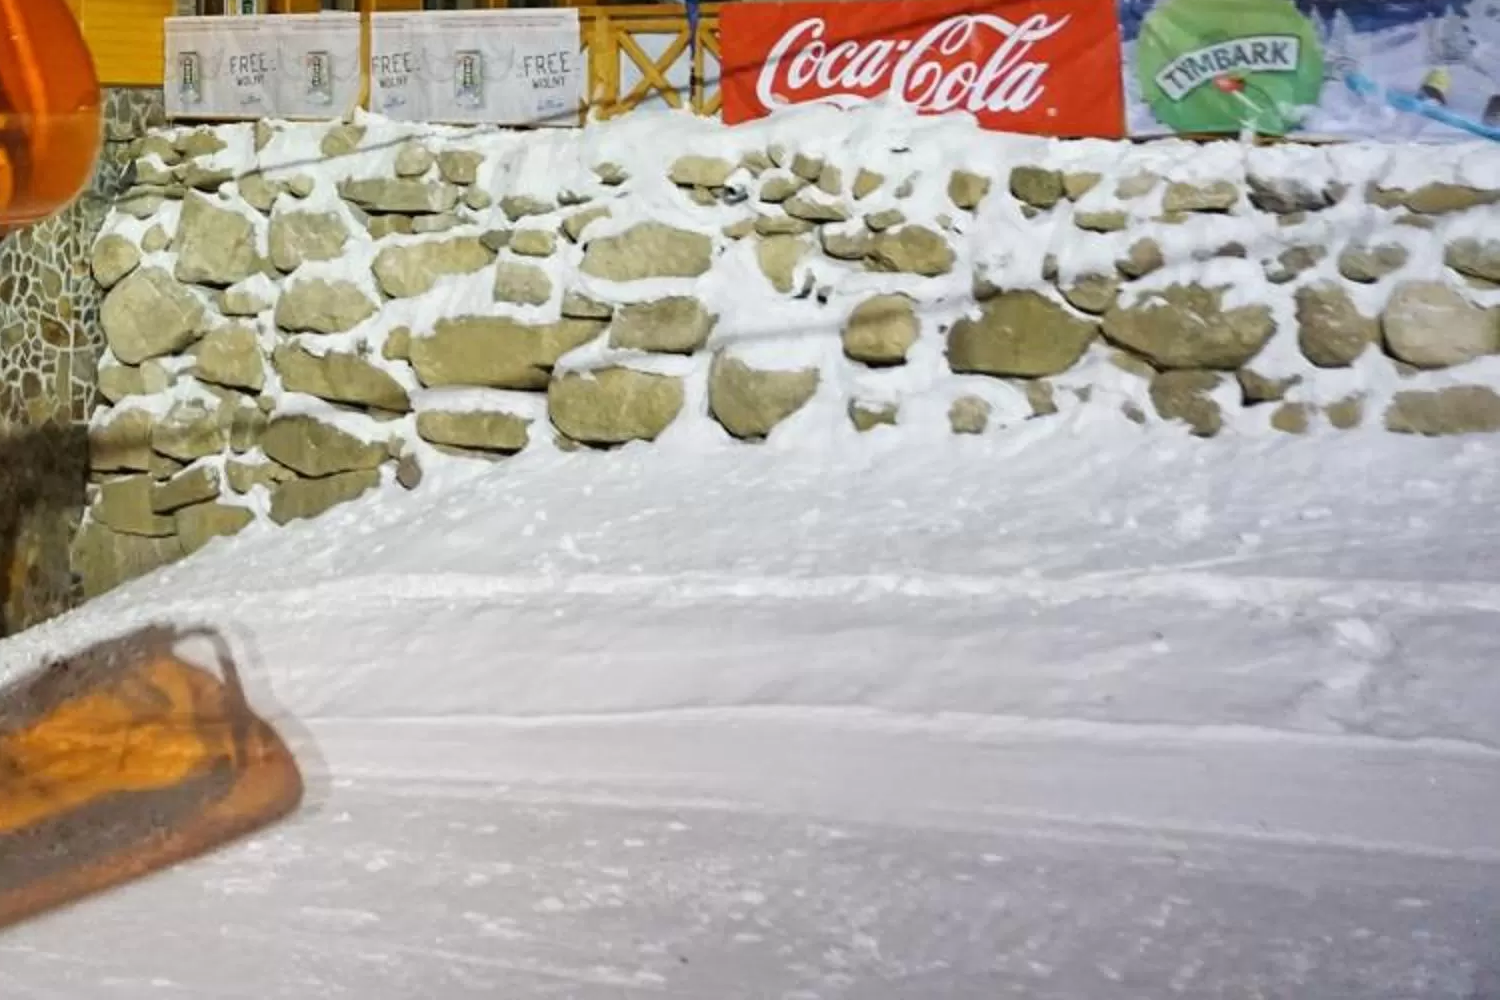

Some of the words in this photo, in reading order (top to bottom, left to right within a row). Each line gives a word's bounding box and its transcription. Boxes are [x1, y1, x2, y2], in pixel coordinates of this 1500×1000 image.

[372, 52, 414, 75] FREE
[523, 51, 571, 76] FREE
[756, 13, 1072, 113] Coca-Cola
[1163, 42, 1289, 90] TYMBARK
